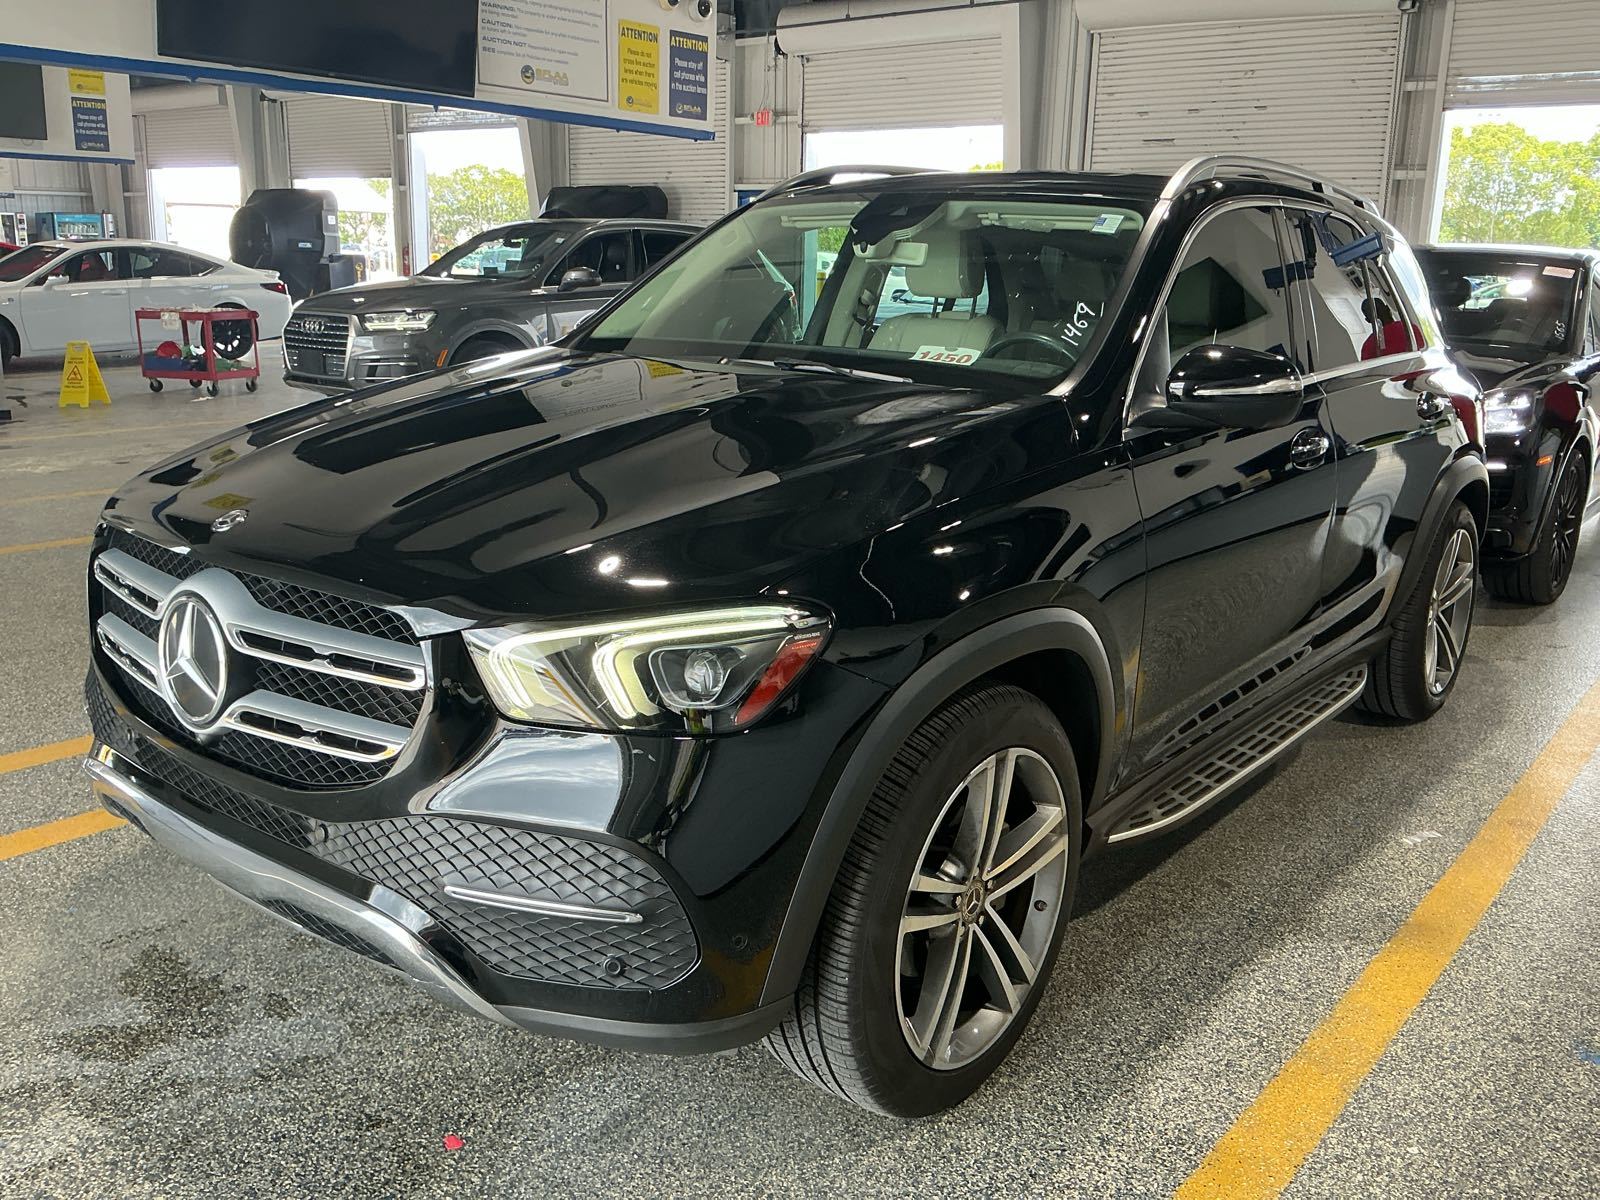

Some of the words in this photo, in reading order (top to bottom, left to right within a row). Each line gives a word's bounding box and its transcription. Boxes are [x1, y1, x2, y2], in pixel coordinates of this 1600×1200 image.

[482, 36, 512, 46] AUCTION
[621, 26, 658, 43] ATTENTION
[671, 36, 708, 53] ATTENTION
[675, 58, 687, 67] Please
[688, 60, 697, 70] stay
[681, 72, 695, 81] phones
[696, 74, 705, 82] while
[644, 80, 657, 89] moving
[697, 86, 707, 94] lanes
[72, 101, 106, 110] ATTENTION
[756, 111, 769, 126] EXIT
[1060, 301, 1096, 346] 1469
[1554, 320, 1566, 340] 1565
[918, 350, 974, 364] 1450
